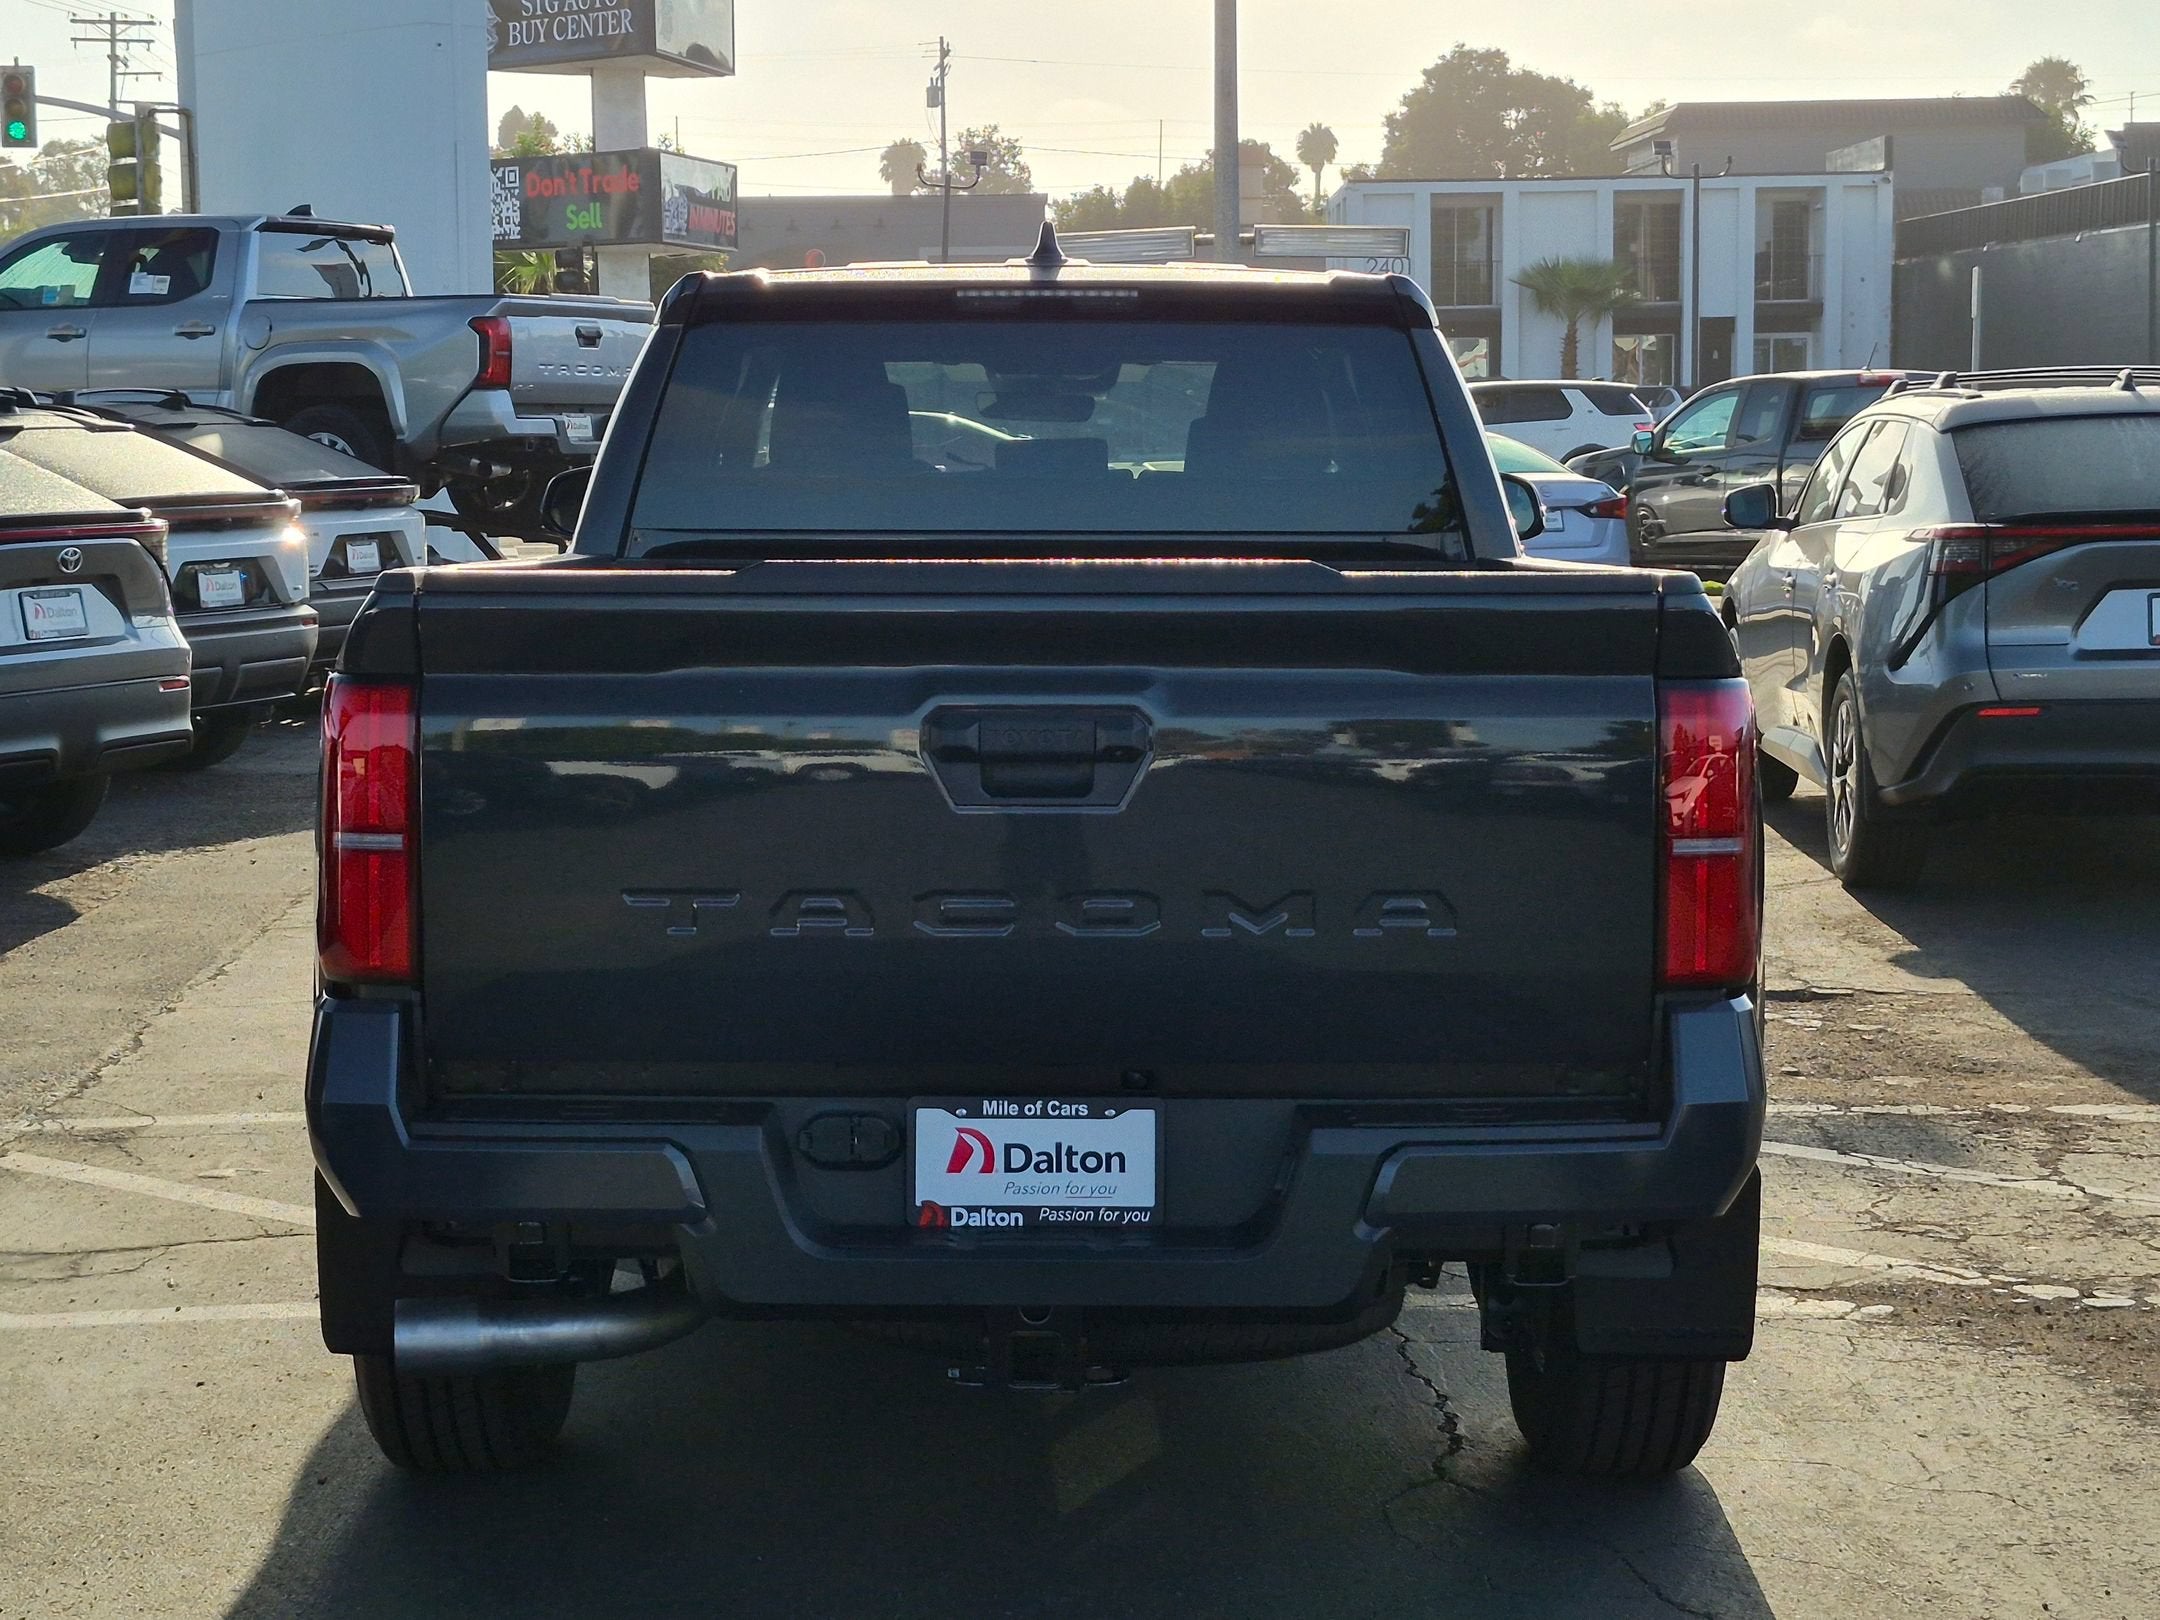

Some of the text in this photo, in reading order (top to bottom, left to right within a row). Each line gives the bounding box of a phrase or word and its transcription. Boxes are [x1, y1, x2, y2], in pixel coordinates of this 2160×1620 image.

[508, 8, 634, 46] BUY CENTER
[526, 163, 640, 198] Don't Trade
[566, 202, 603, 231] Sell
[1366, 257, 1412, 275] 2401
[47, 606, 78, 619] Dalton
[621, 888, 1458, 937] TACOMA
[982, 1100, 1089, 1116] Mile of Cars
[1003, 1142, 1126, 1174] Dalton
[1003, 1181, 1117, 1197] Passion for you
[951, 1207, 1151, 1227] Dalton Passion for you
